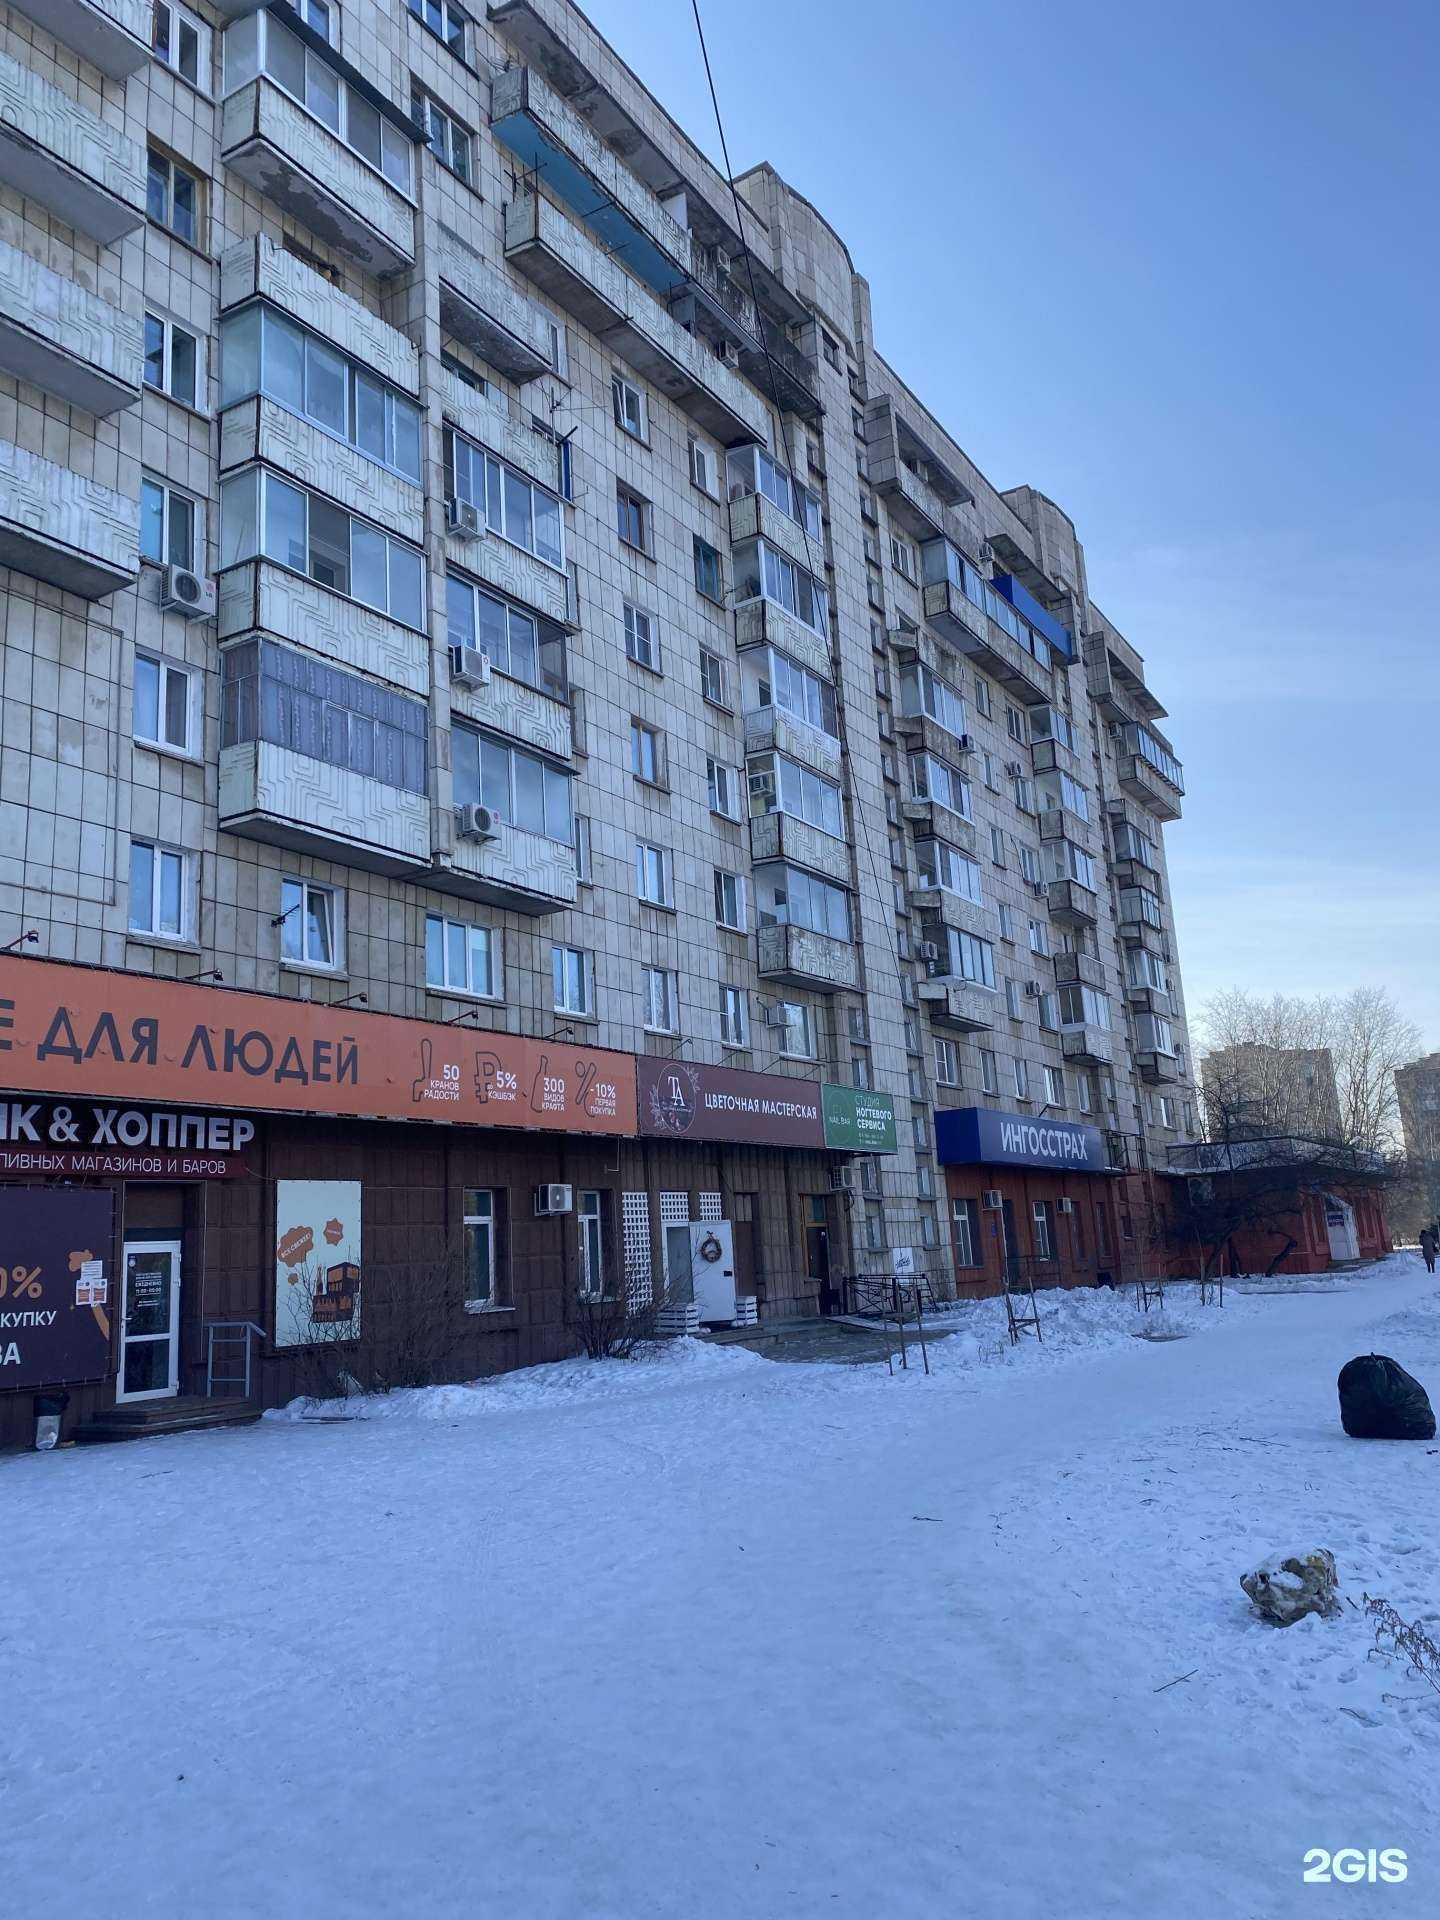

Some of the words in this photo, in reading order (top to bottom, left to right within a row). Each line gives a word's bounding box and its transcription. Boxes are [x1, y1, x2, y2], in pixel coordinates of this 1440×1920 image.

[36, 1006, 159, 1065] ДЛЯ
[181, 1024, 358, 1086] ЛЮДЕЙ
[443, 1064, 460, 1081] 50
[496, 1070, 517, 1090] 5%
[430, 1080, 460, 1091] КРАНОВ
[543, 1077, 565, 1093] 300
[424, 1089, 460, 1100] РАДОСТИ
[855, 1095, 880, 1107] СТУДИЯ
[704, 1092, 760, 1113] ЦВЕТОЧНАЯ
[762, 1099, 817, 1119] МАСТЕРСКАЯ
[855, 1107, 892, 1120] НОГТЕВОГО
[49, 1106, 80, 1143] &
[92, 1108, 255, 1151] ХОППЕР
[856, 1118, 886, 1131] СЕРВИСА
[1000, 1122, 1088, 1160] ИНГОССТРАХ
[71, 1155, 162, 1173] МАГАЗИНОВ
[168, 1158, 177, 1173] И
[182, 1159, 226, 1174] БАРОВ
